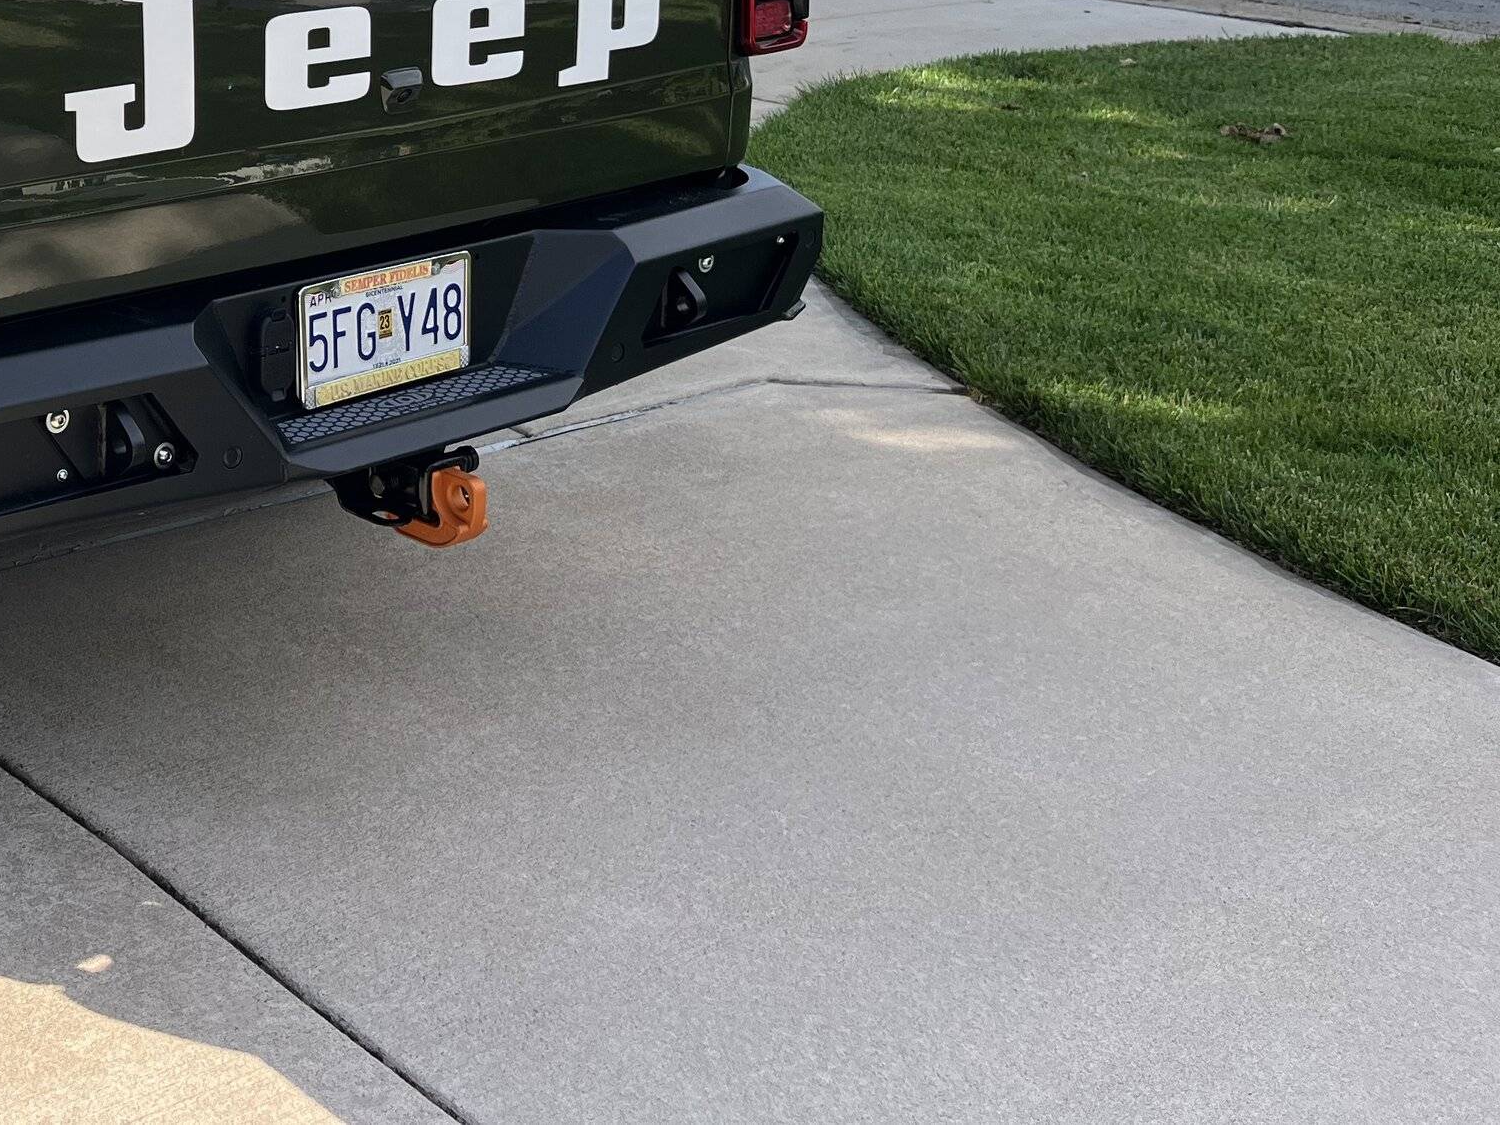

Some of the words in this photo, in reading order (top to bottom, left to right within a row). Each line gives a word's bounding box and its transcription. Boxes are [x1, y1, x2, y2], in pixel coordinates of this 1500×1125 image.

[345, 272, 387, 293] SEMPER
[390, 265, 429, 286] FIDELIS
[309, 302, 377, 373] 5FG
[397, 283, 462, 351] Y48
[379, 314, 390, 330] 23
